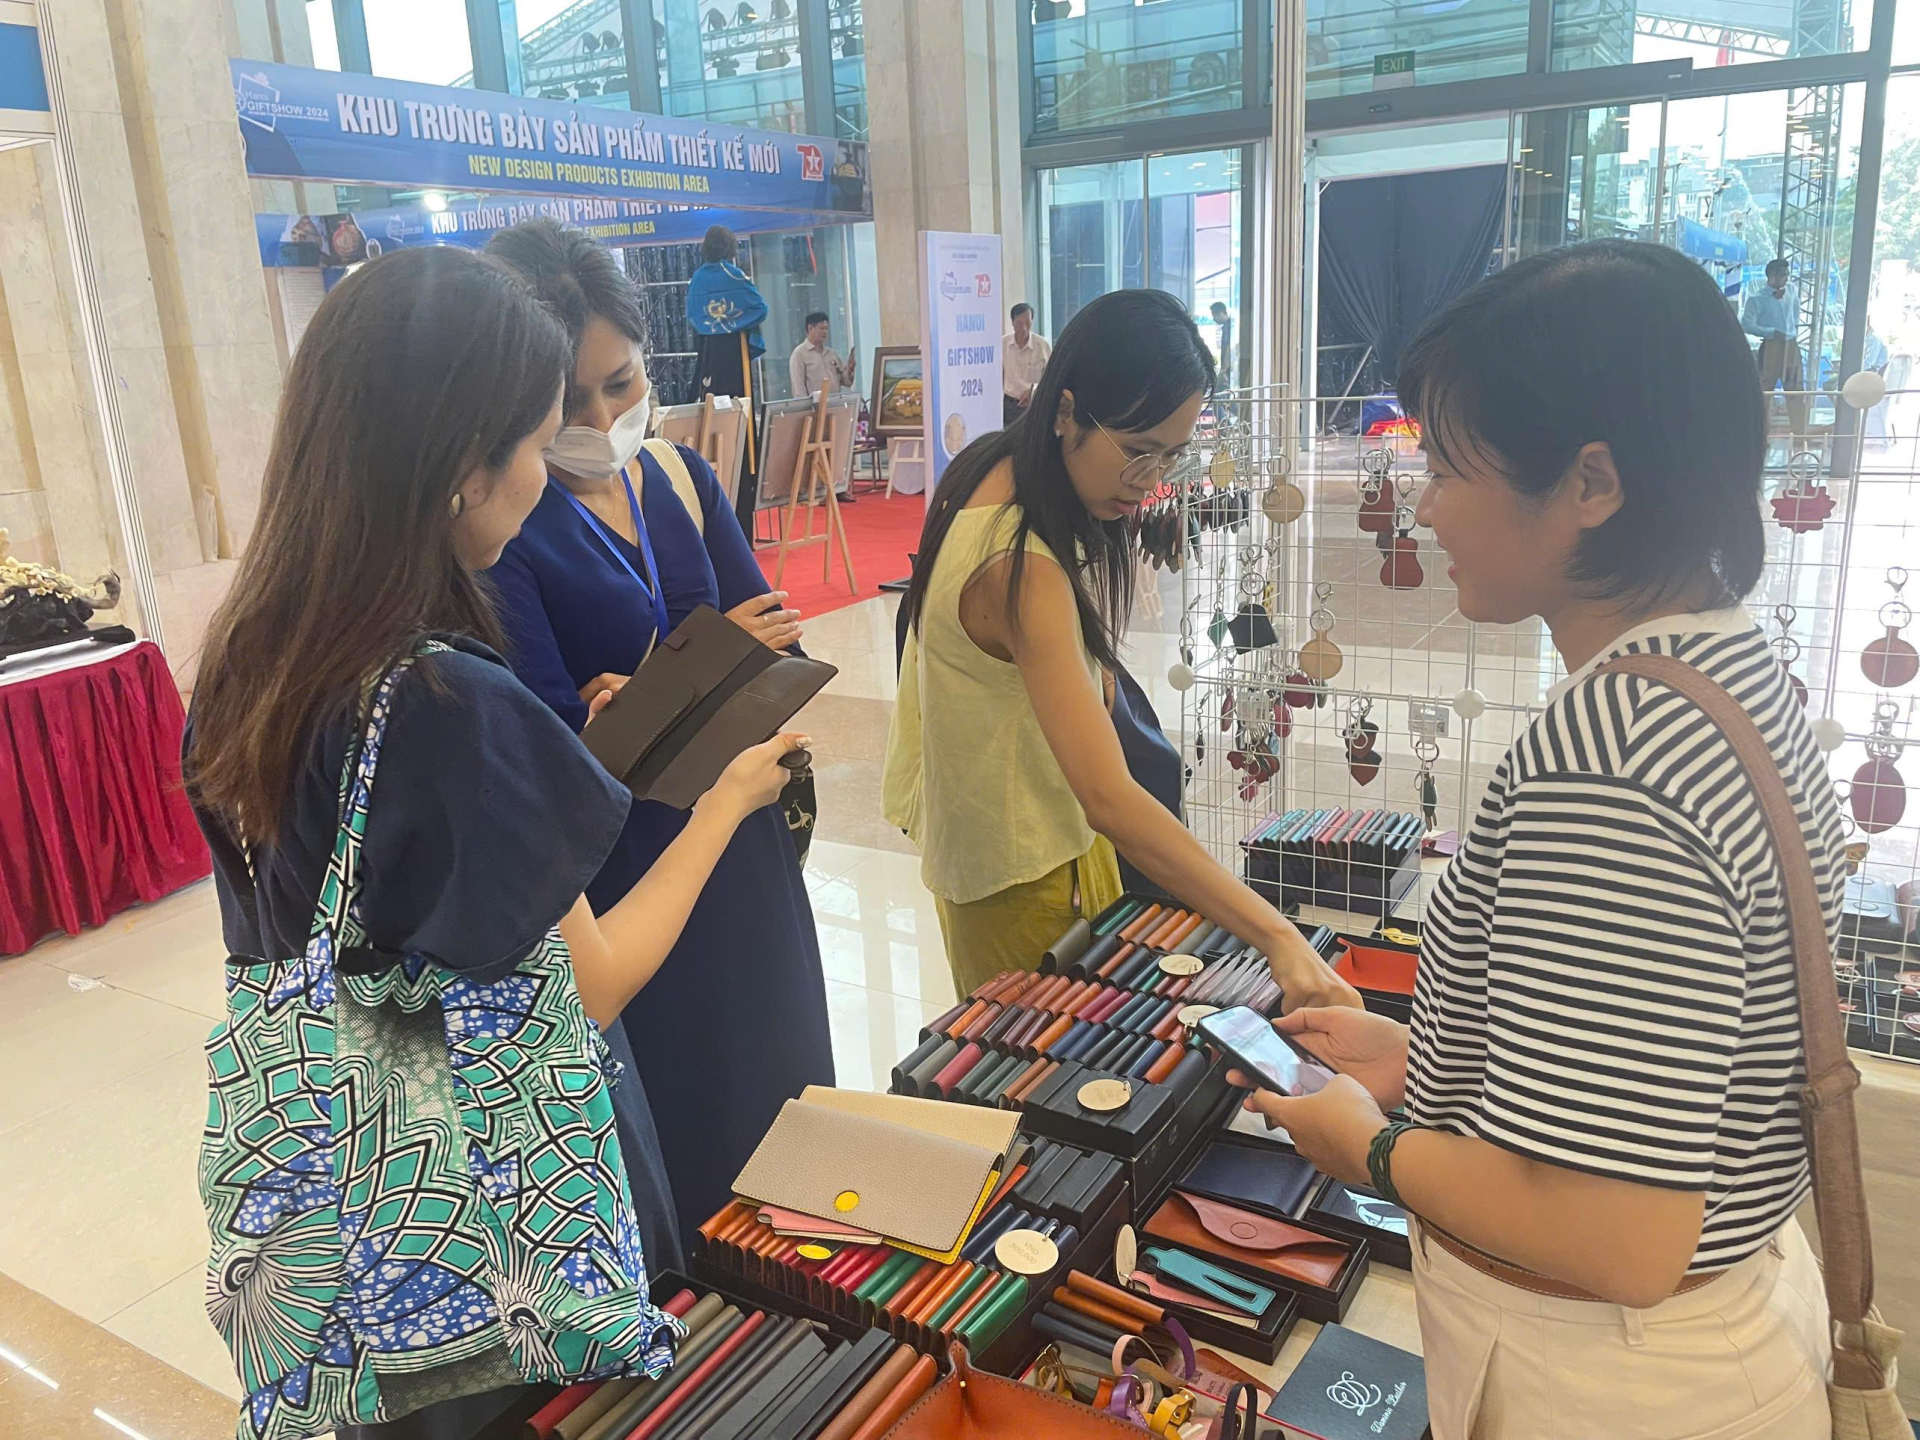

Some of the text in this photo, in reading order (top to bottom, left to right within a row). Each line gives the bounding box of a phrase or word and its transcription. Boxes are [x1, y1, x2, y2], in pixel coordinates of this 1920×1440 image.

[1382, 57, 1407, 73] EXIT
[247, 101, 303, 115] GIFTSHOW
[306, 107, 329, 117] 2024
[336, 93, 782, 174] KHU TRƯNG BÀY SẢN PHẨM THIẾT KẾ MỚI
[468, 154, 710, 193] NEW DESIGN PRODUCTS EXHIBITION AREA
[430, 211, 459, 235] KHU
[585, 220, 655, 238] EXHIBITION AREA
[956, 313, 985, 333] HANOI
[947, 345, 995, 367] GIFTSHOW
[961, 378, 983, 397] 2024
